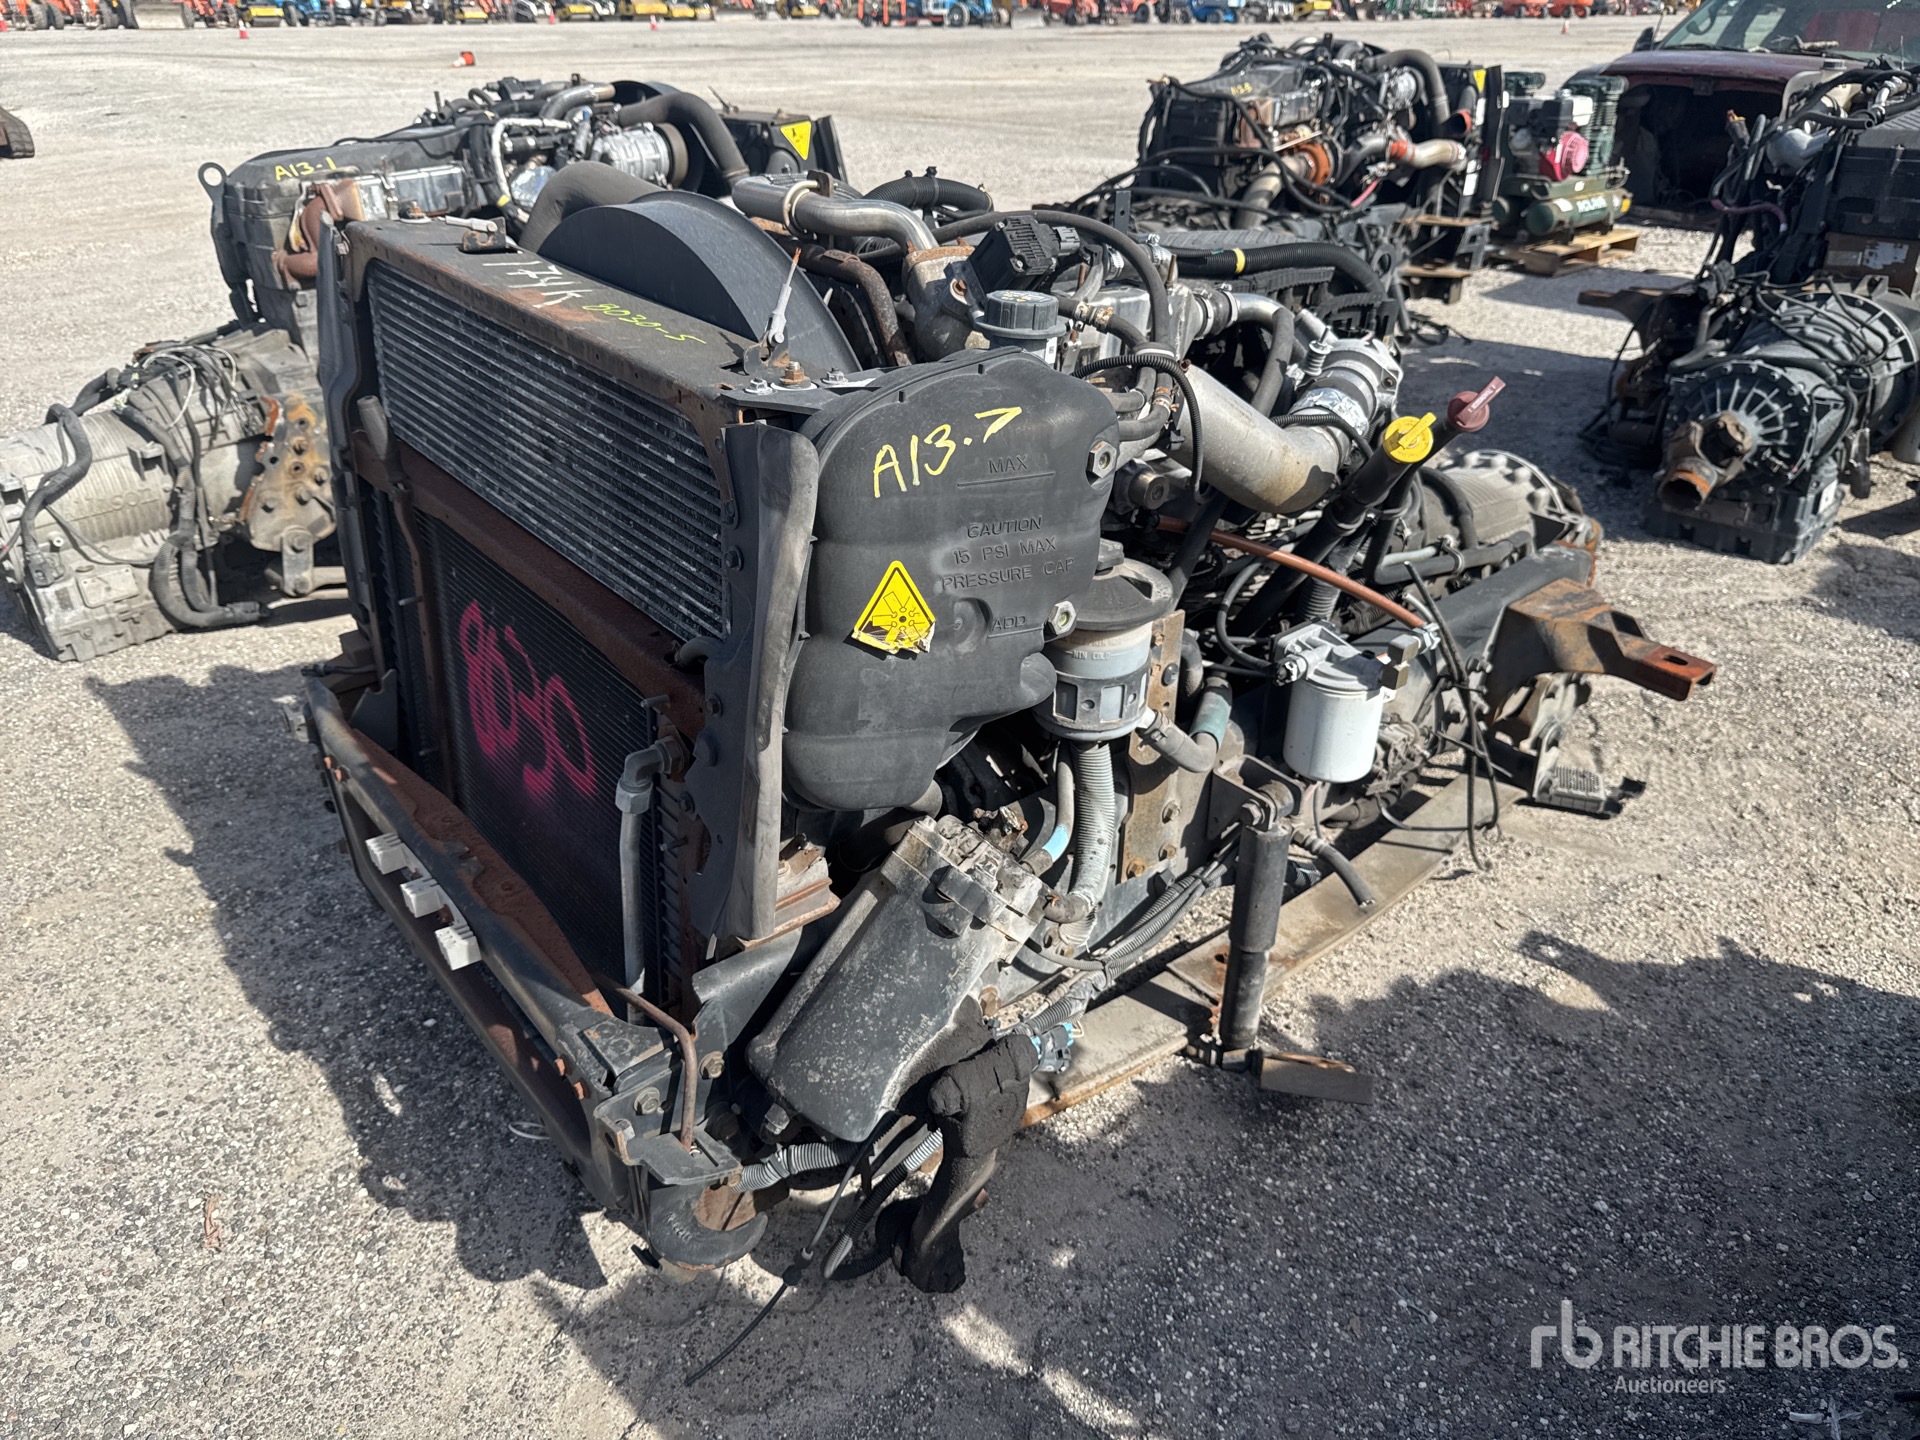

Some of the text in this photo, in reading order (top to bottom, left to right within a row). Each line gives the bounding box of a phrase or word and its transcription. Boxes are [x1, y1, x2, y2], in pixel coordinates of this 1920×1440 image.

[275, 156, 337, 181] A13-1
[582, 303, 706, 344] 8030-5
[988, 454, 1028, 475] MAX
[966, 515, 1042, 539] CAUTION
[953, 537, 1056, 565] 15 PSI MAX
[941, 558, 1074, 591] PRESSURE CAP
[991, 615, 1026, 633] ADD
[1092, 651, 1111, 661] COLD
[459, 599, 597, 800] 8030
